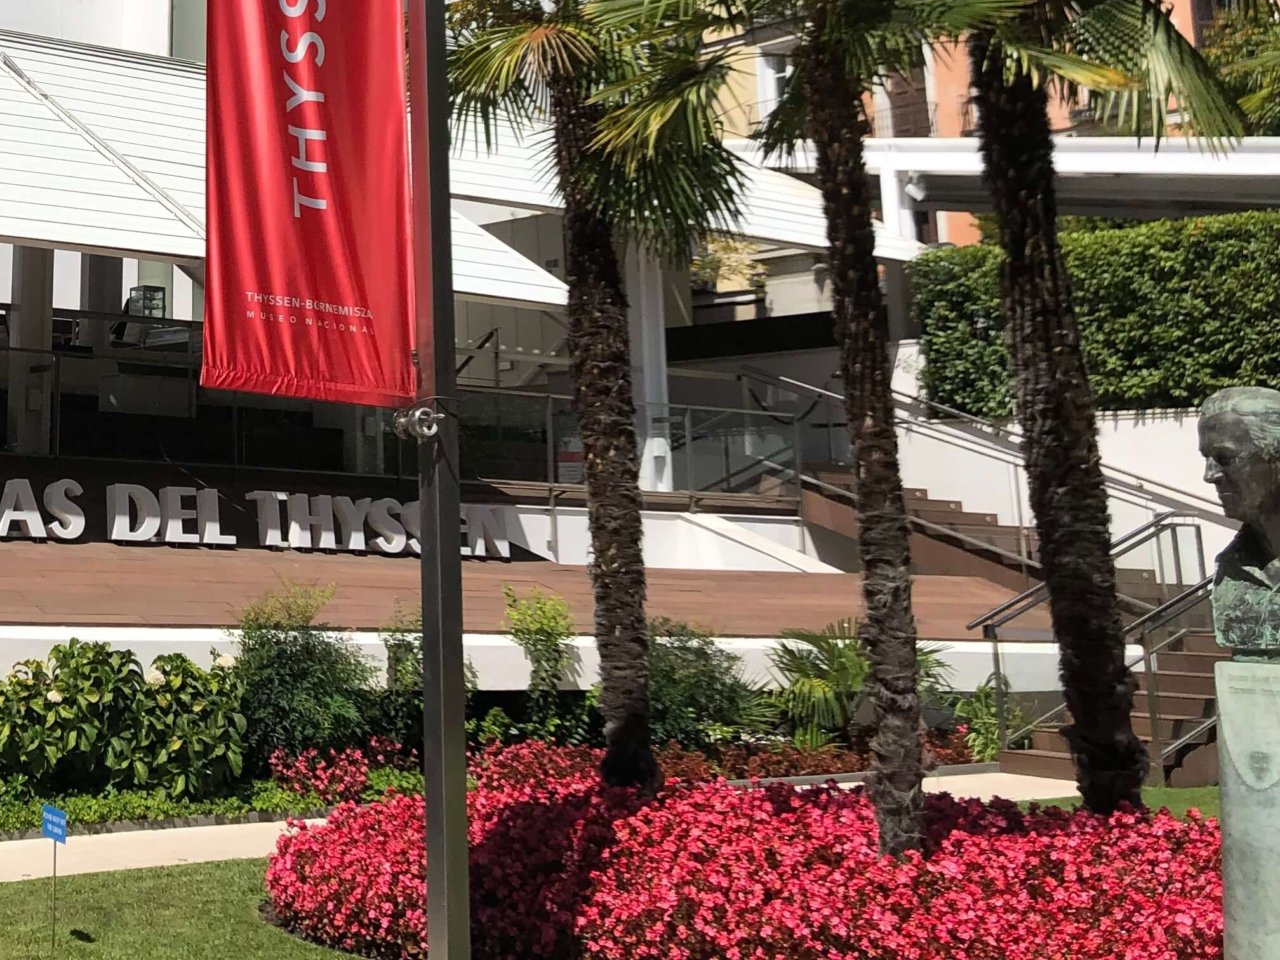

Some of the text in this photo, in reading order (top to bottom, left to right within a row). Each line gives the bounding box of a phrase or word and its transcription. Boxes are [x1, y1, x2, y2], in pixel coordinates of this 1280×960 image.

[246, 292, 373, 319] THYSSEN-BORNEMISZA
[246, 311, 375, 335] MUSEO NACIONAL
[106, 483, 237, 543] DEL
